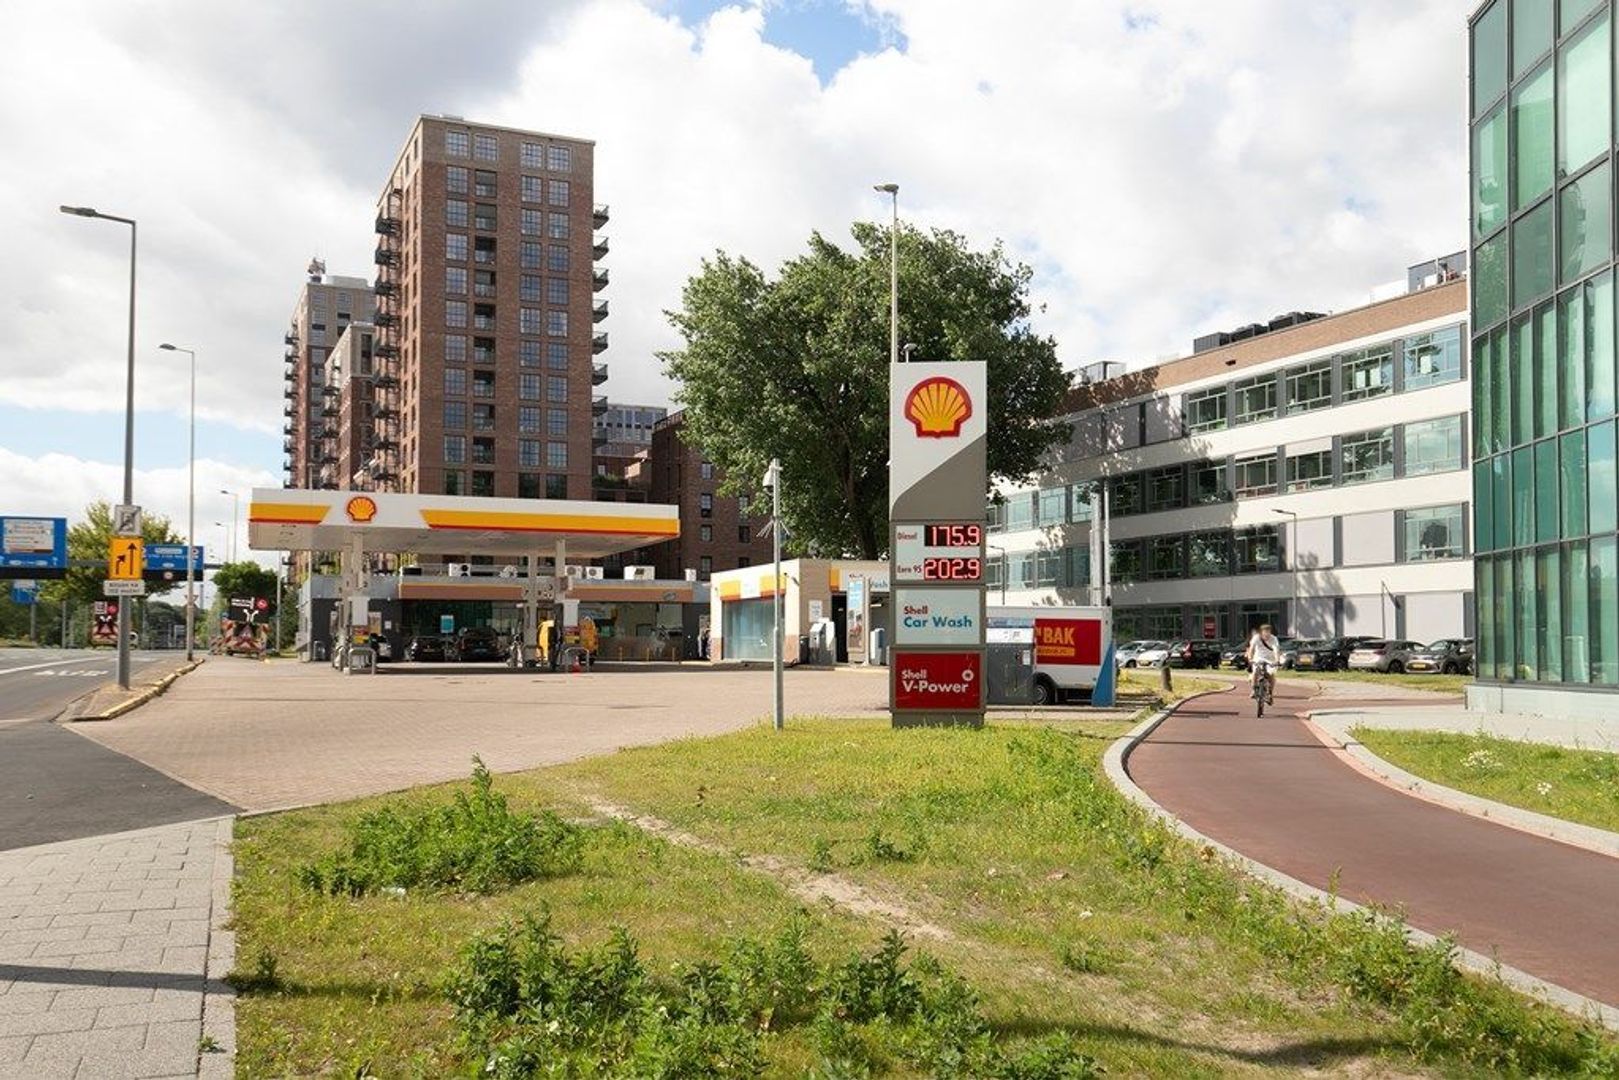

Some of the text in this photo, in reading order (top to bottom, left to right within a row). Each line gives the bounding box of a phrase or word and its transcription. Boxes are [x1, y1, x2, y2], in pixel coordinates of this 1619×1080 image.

[897, 531, 918, 540] Diesel
[931, 526, 980, 546] 175.9
[913, 564, 922, 574] 95
[924, 559, 980, 579] 202.9
[903, 605, 929, 615] Shell
[903, 615, 973, 628] Car Wash
[1043, 626, 1076, 646] BAK
[901, 668, 928, 680] Shell
[901, 680, 969, 693] V-Power
